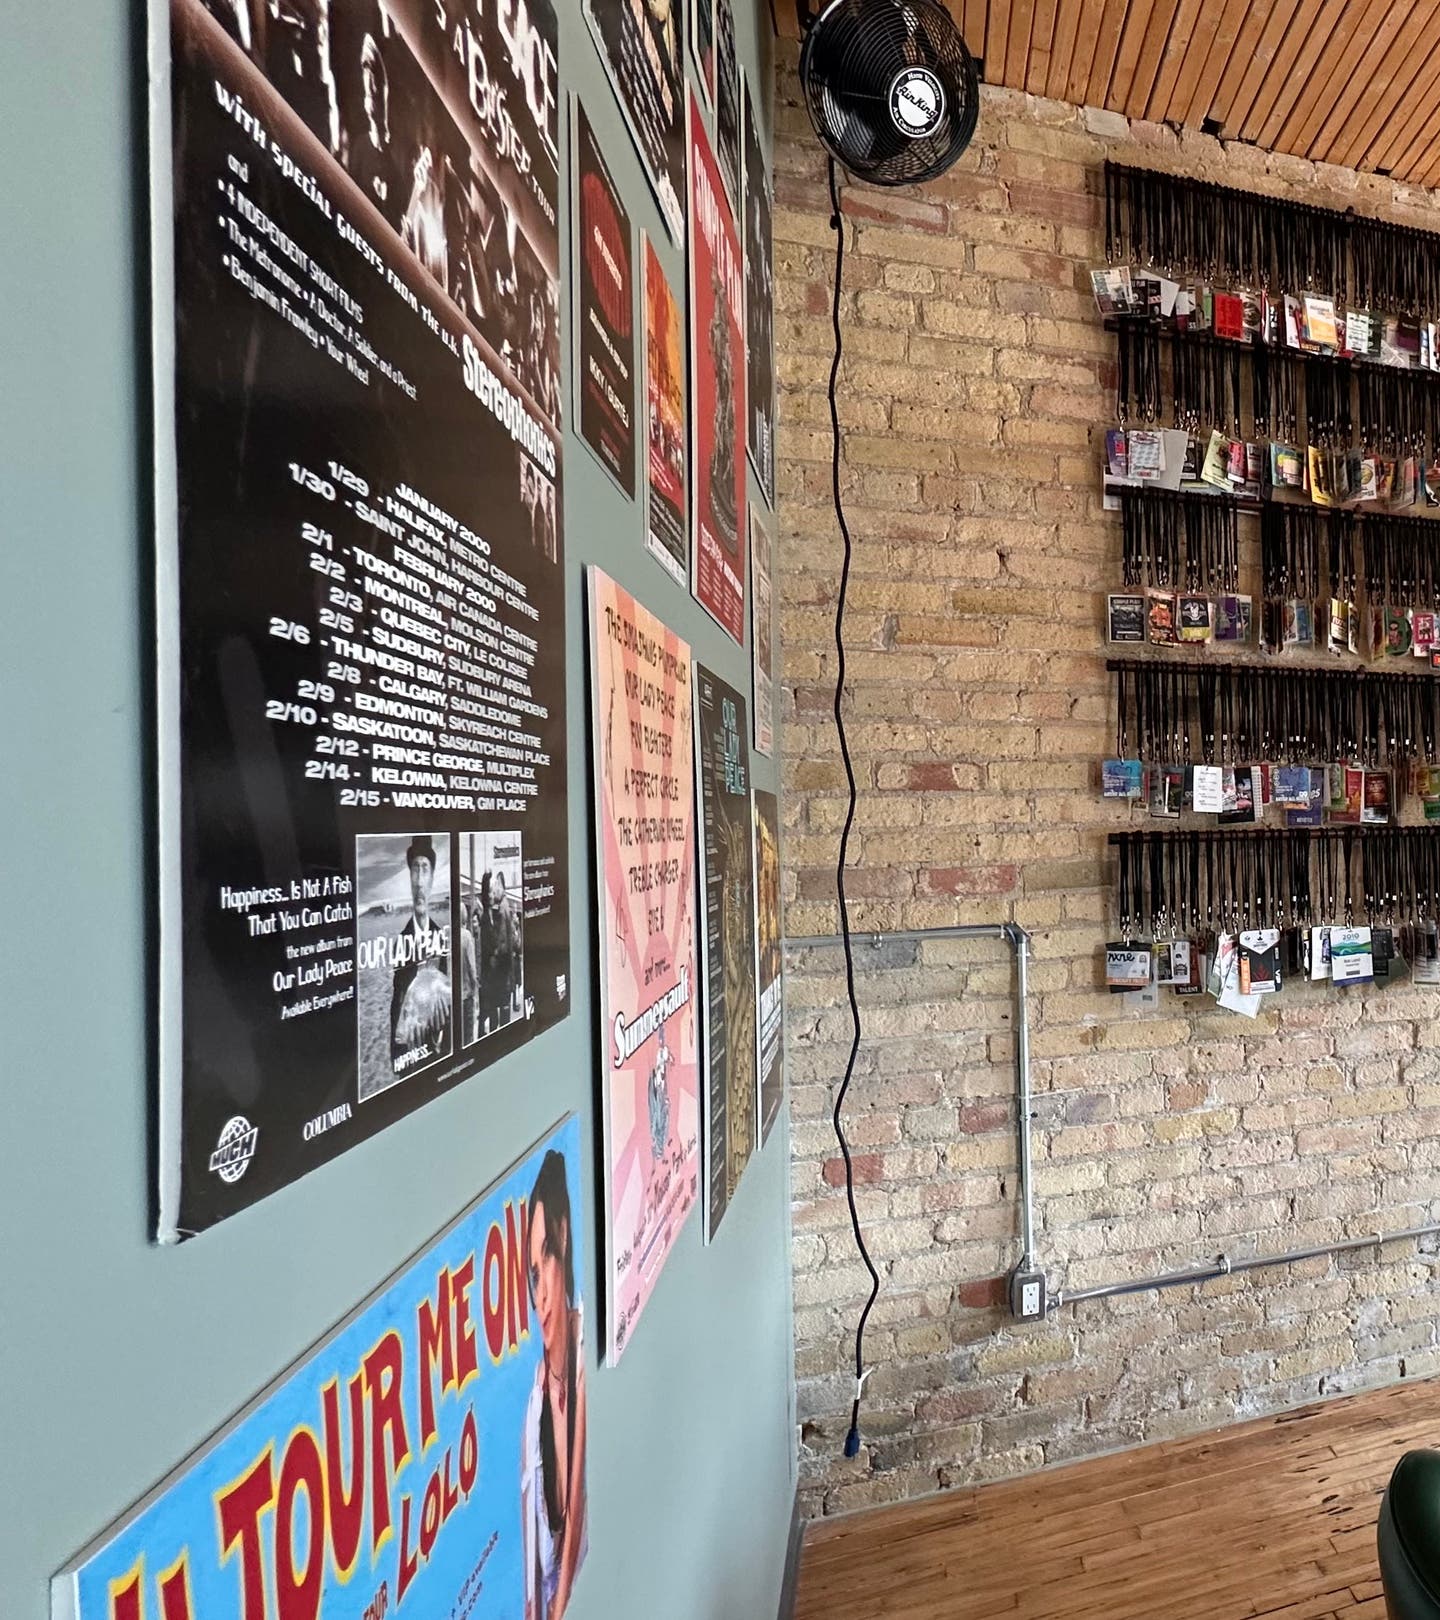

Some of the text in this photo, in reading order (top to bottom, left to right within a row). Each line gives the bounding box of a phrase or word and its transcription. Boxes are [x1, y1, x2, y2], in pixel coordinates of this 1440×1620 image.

[228, 154, 249, 183] and
[532, 174, 556, 226] TOUR
[227, 217, 248, 252] The
[227, 183, 363, 324] 4 INDEPENDENT SHORT FILMS
[694, 143, 743, 340] SIMPLE PLAN
[231, 254, 280, 312] Benjamin
[462, 333, 557, 478] Stereophonics
[288, 463, 540, 622] 1/30 SAINT JOHN, HARBOUR CENTRE
[328, 461, 527, 598] 1/29 HALIFAX, METRO CENTRE
[395, 483, 491, 556] JANUARY 2000
[301, 522, 538, 652] 2/1 TORONTO, AIR CANADA CENTRE
[394, 545, 497, 613] FEBRUARY 2000
[309, 552, 535, 667] 2/2 MONTREAL, MOLSON CENTRE
[329, 586, 363, 613] 2/3
[380, 607, 442, 645] QUEBEC
[443, 633, 472, 660] CITY,
[473, 646, 488, 664] LE
[605, 606, 622, 644] THE
[624, 620, 657, 667] SMASHING
[269, 616, 548, 719] 2/6 THUNDER BAY, FT. WILLIAM GARDENS
[319, 607, 532, 698] 2/5 SUDBURY, SUDBURY ARENA
[297, 679, 542, 749] 2/9 EDMONTON, SKYREACH CENTRE
[327, 661, 522, 728] 2/8 CALGARY, SADDLEDOME
[639, 675, 655, 711] LADY
[656, 687, 675, 720] PEACE
[265, 699, 551, 766] 2/10 SASKATOON, SASKATCHEWAN PLACE
[315, 735, 535, 780] 2/12 PRINCE GEORGE, MULTIPLEX
[644, 724, 672, 759] FIGHTERS
[304, 760, 538, 796] 2/14 KELOWNA, KELOWNA CENTRE
[340, 788, 527, 812] 2/15 VANCOUVER, GM PLACE
[624, 767, 679, 801] A PERFECT CIRCLE
[617, 816, 632, 848] THE
[290, 880, 301, 900] Is
[302, 878, 321, 899] Not
[322, 876, 331, 896] A
[332, 875, 352, 895] Fish
[628, 859, 679, 893] TREBLE CHARGER
[247, 902, 353, 937] That You Can Catch
[359, 925, 451, 970] OUR LADY PEACE
[273, 958, 353, 992] Our Lady Peace
[286, 945, 300, 959] the
[300, 944, 315, 956] new
[614, 964, 690, 1070] Summersault
[303, 1103, 353, 1141] COLUMBIA
[213, 1328, 411, 1620] TOUR
[417, 1250, 480, 1456] ME
[482, 1196, 530, 1365] ON
